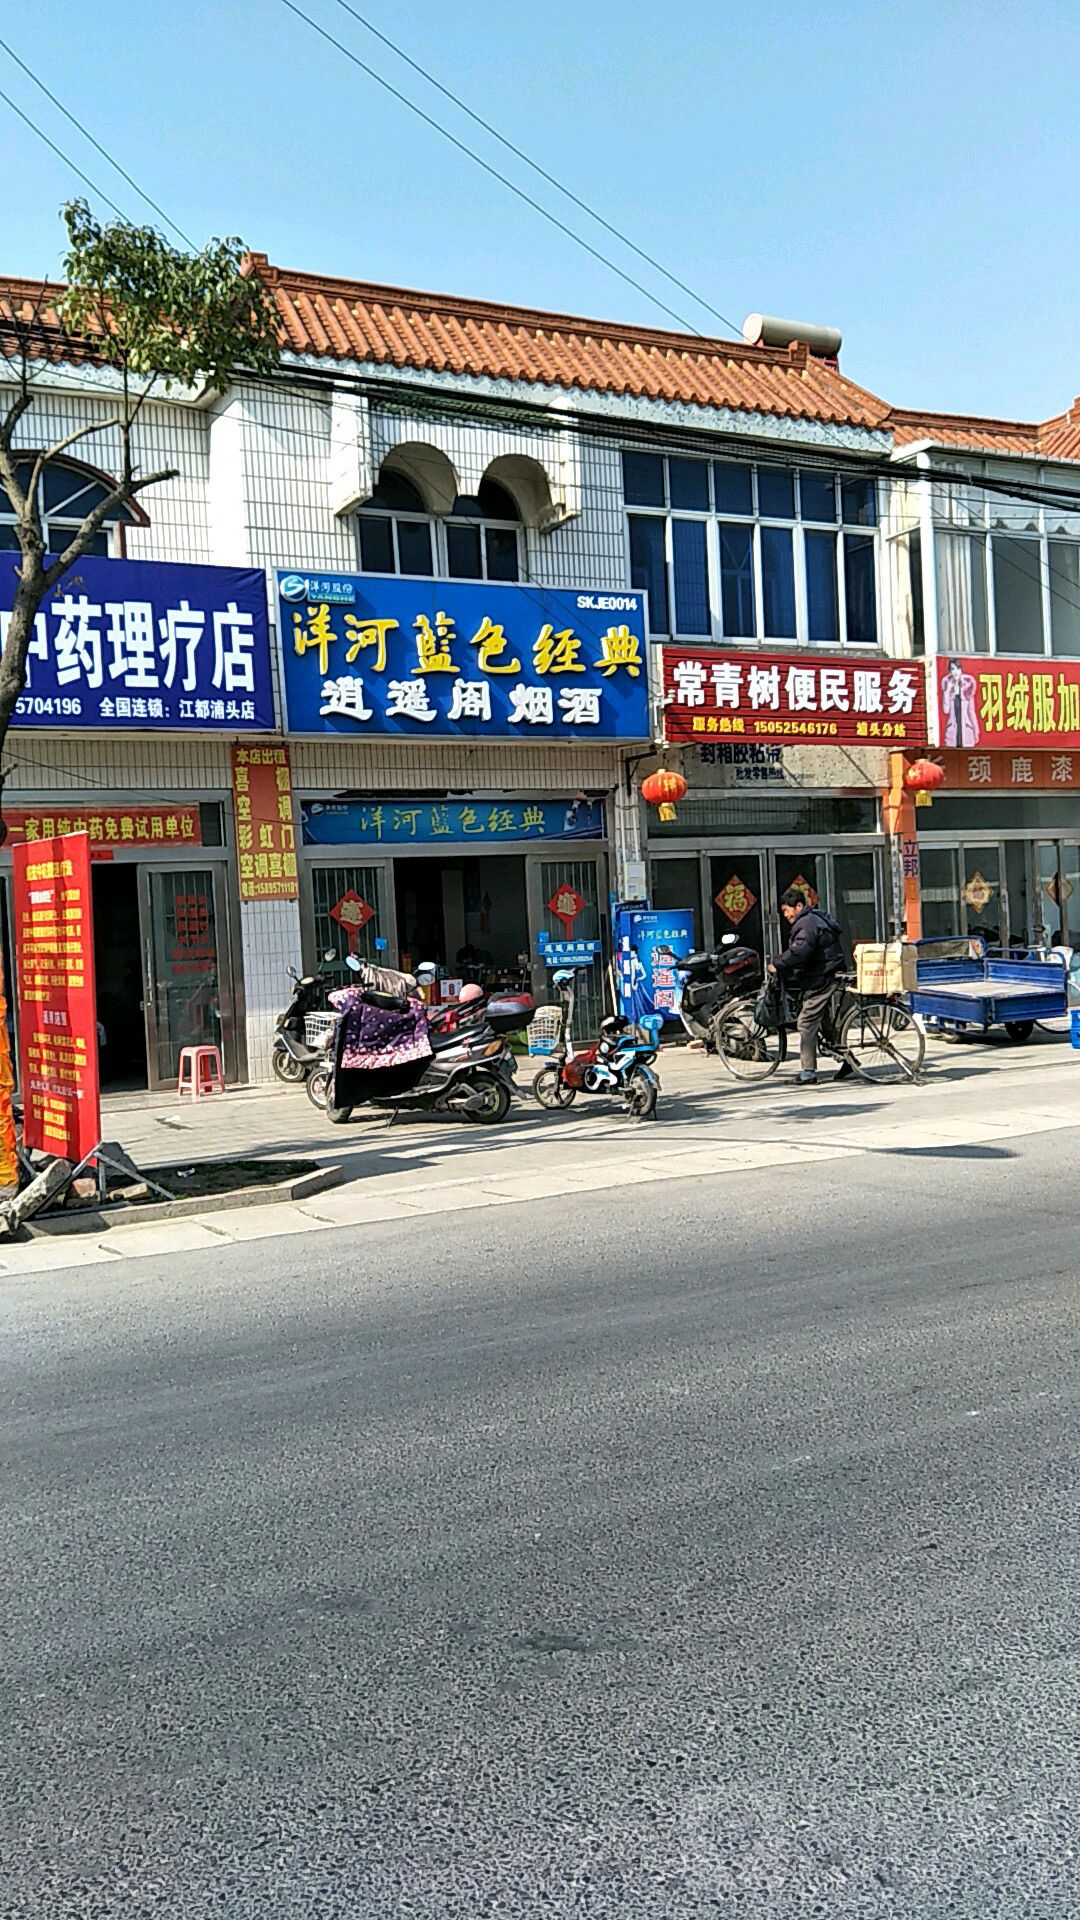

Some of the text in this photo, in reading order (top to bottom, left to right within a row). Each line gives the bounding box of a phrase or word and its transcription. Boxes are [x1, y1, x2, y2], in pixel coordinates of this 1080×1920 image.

[576, 595, 638, 611] SKJE0014
[319, 675, 602, 724] 逍遥阁烟酒
[673, 661, 917, 715] 常青树便民服务
[979, 672, 1080, 734] 羽绒服加
[692, 716, 745, 733] 服务热线
[753, 721, 838, 736] 15052546176
[236, 748, 287, 765] 本店出租
[238, 824, 295, 850] 彩虹门
[903, 839, 918, 878] 立邦
[724, 883, 748, 912] 福
